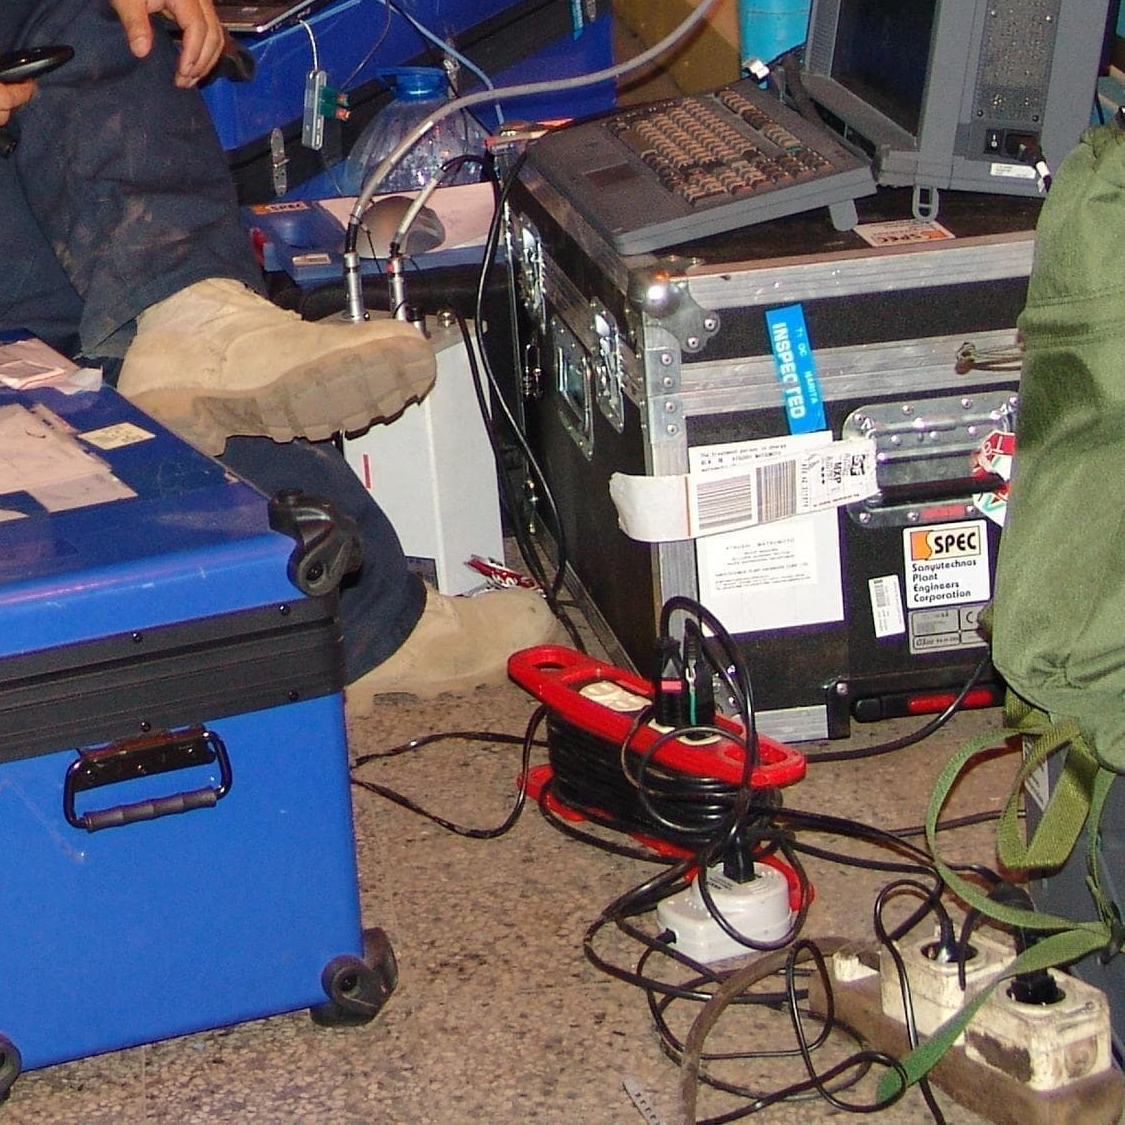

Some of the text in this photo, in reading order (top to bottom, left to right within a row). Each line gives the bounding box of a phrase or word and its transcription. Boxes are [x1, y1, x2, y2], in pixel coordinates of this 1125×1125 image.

[772, 322, 806, 419] INSPECTED
[834, 462, 842, 484] MXP
[934, 532, 977, 554] SPEC
[912, 559, 977, 572] Sanyutechnos
[912, 573, 938, 582] Plant
[913, 582, 960, 593] Engineers
[913, 590, 971, 603] Corporation
